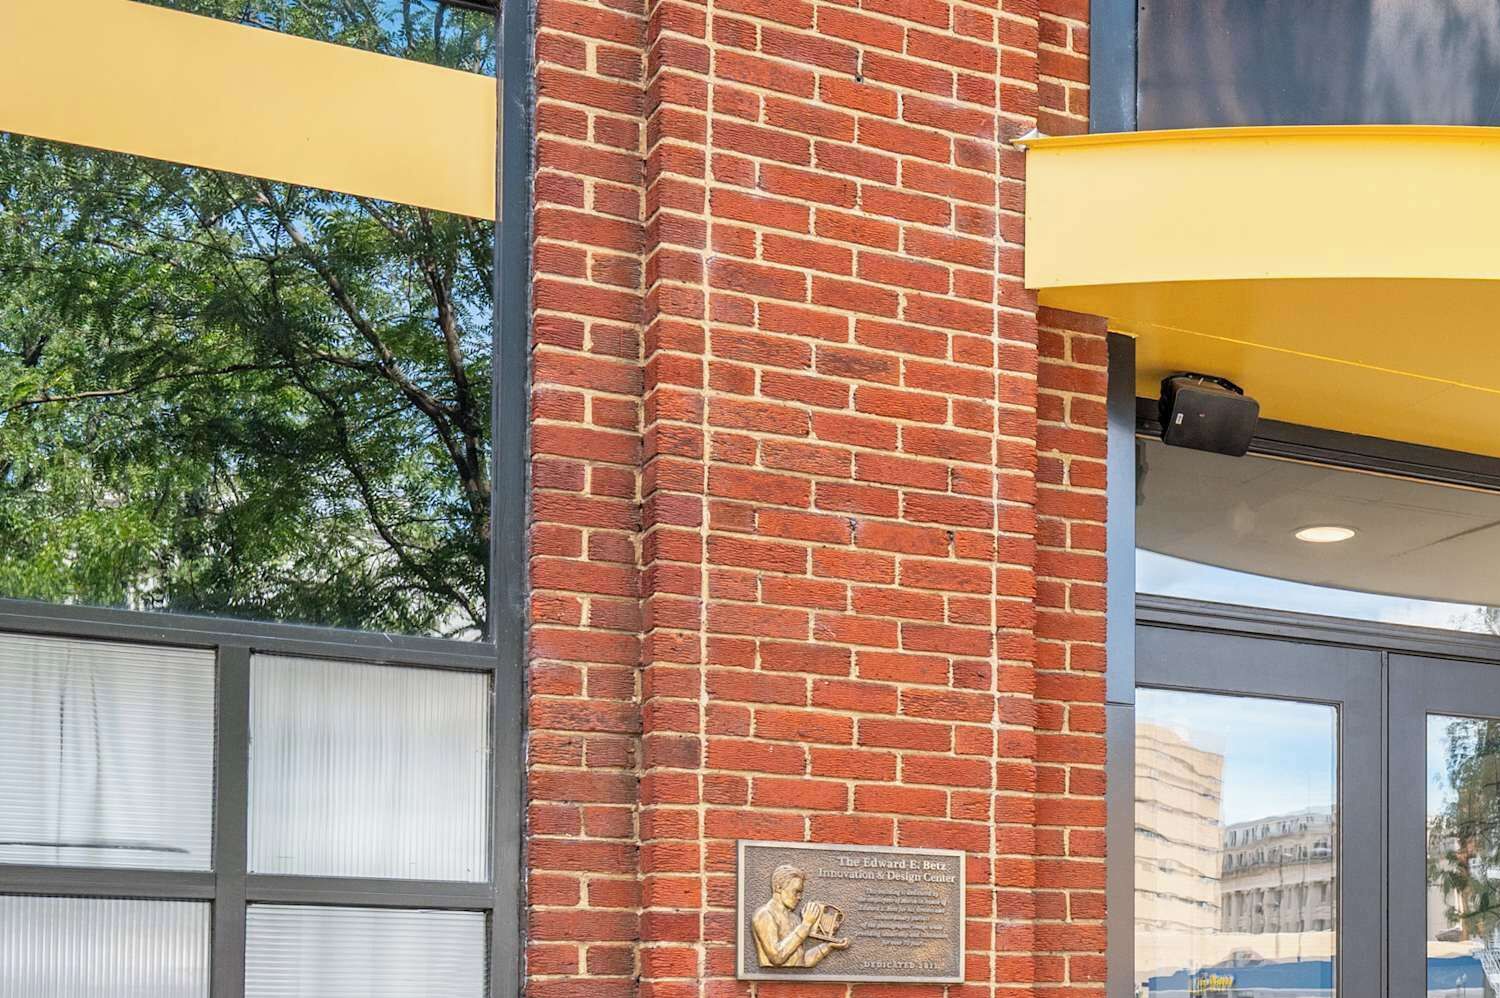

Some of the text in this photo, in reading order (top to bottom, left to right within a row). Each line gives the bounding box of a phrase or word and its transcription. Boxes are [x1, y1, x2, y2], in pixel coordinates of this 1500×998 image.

[840, 856, 946, 871] The Edward E. Betz
[818, 868, 956, 883] Innovation & Design Center
